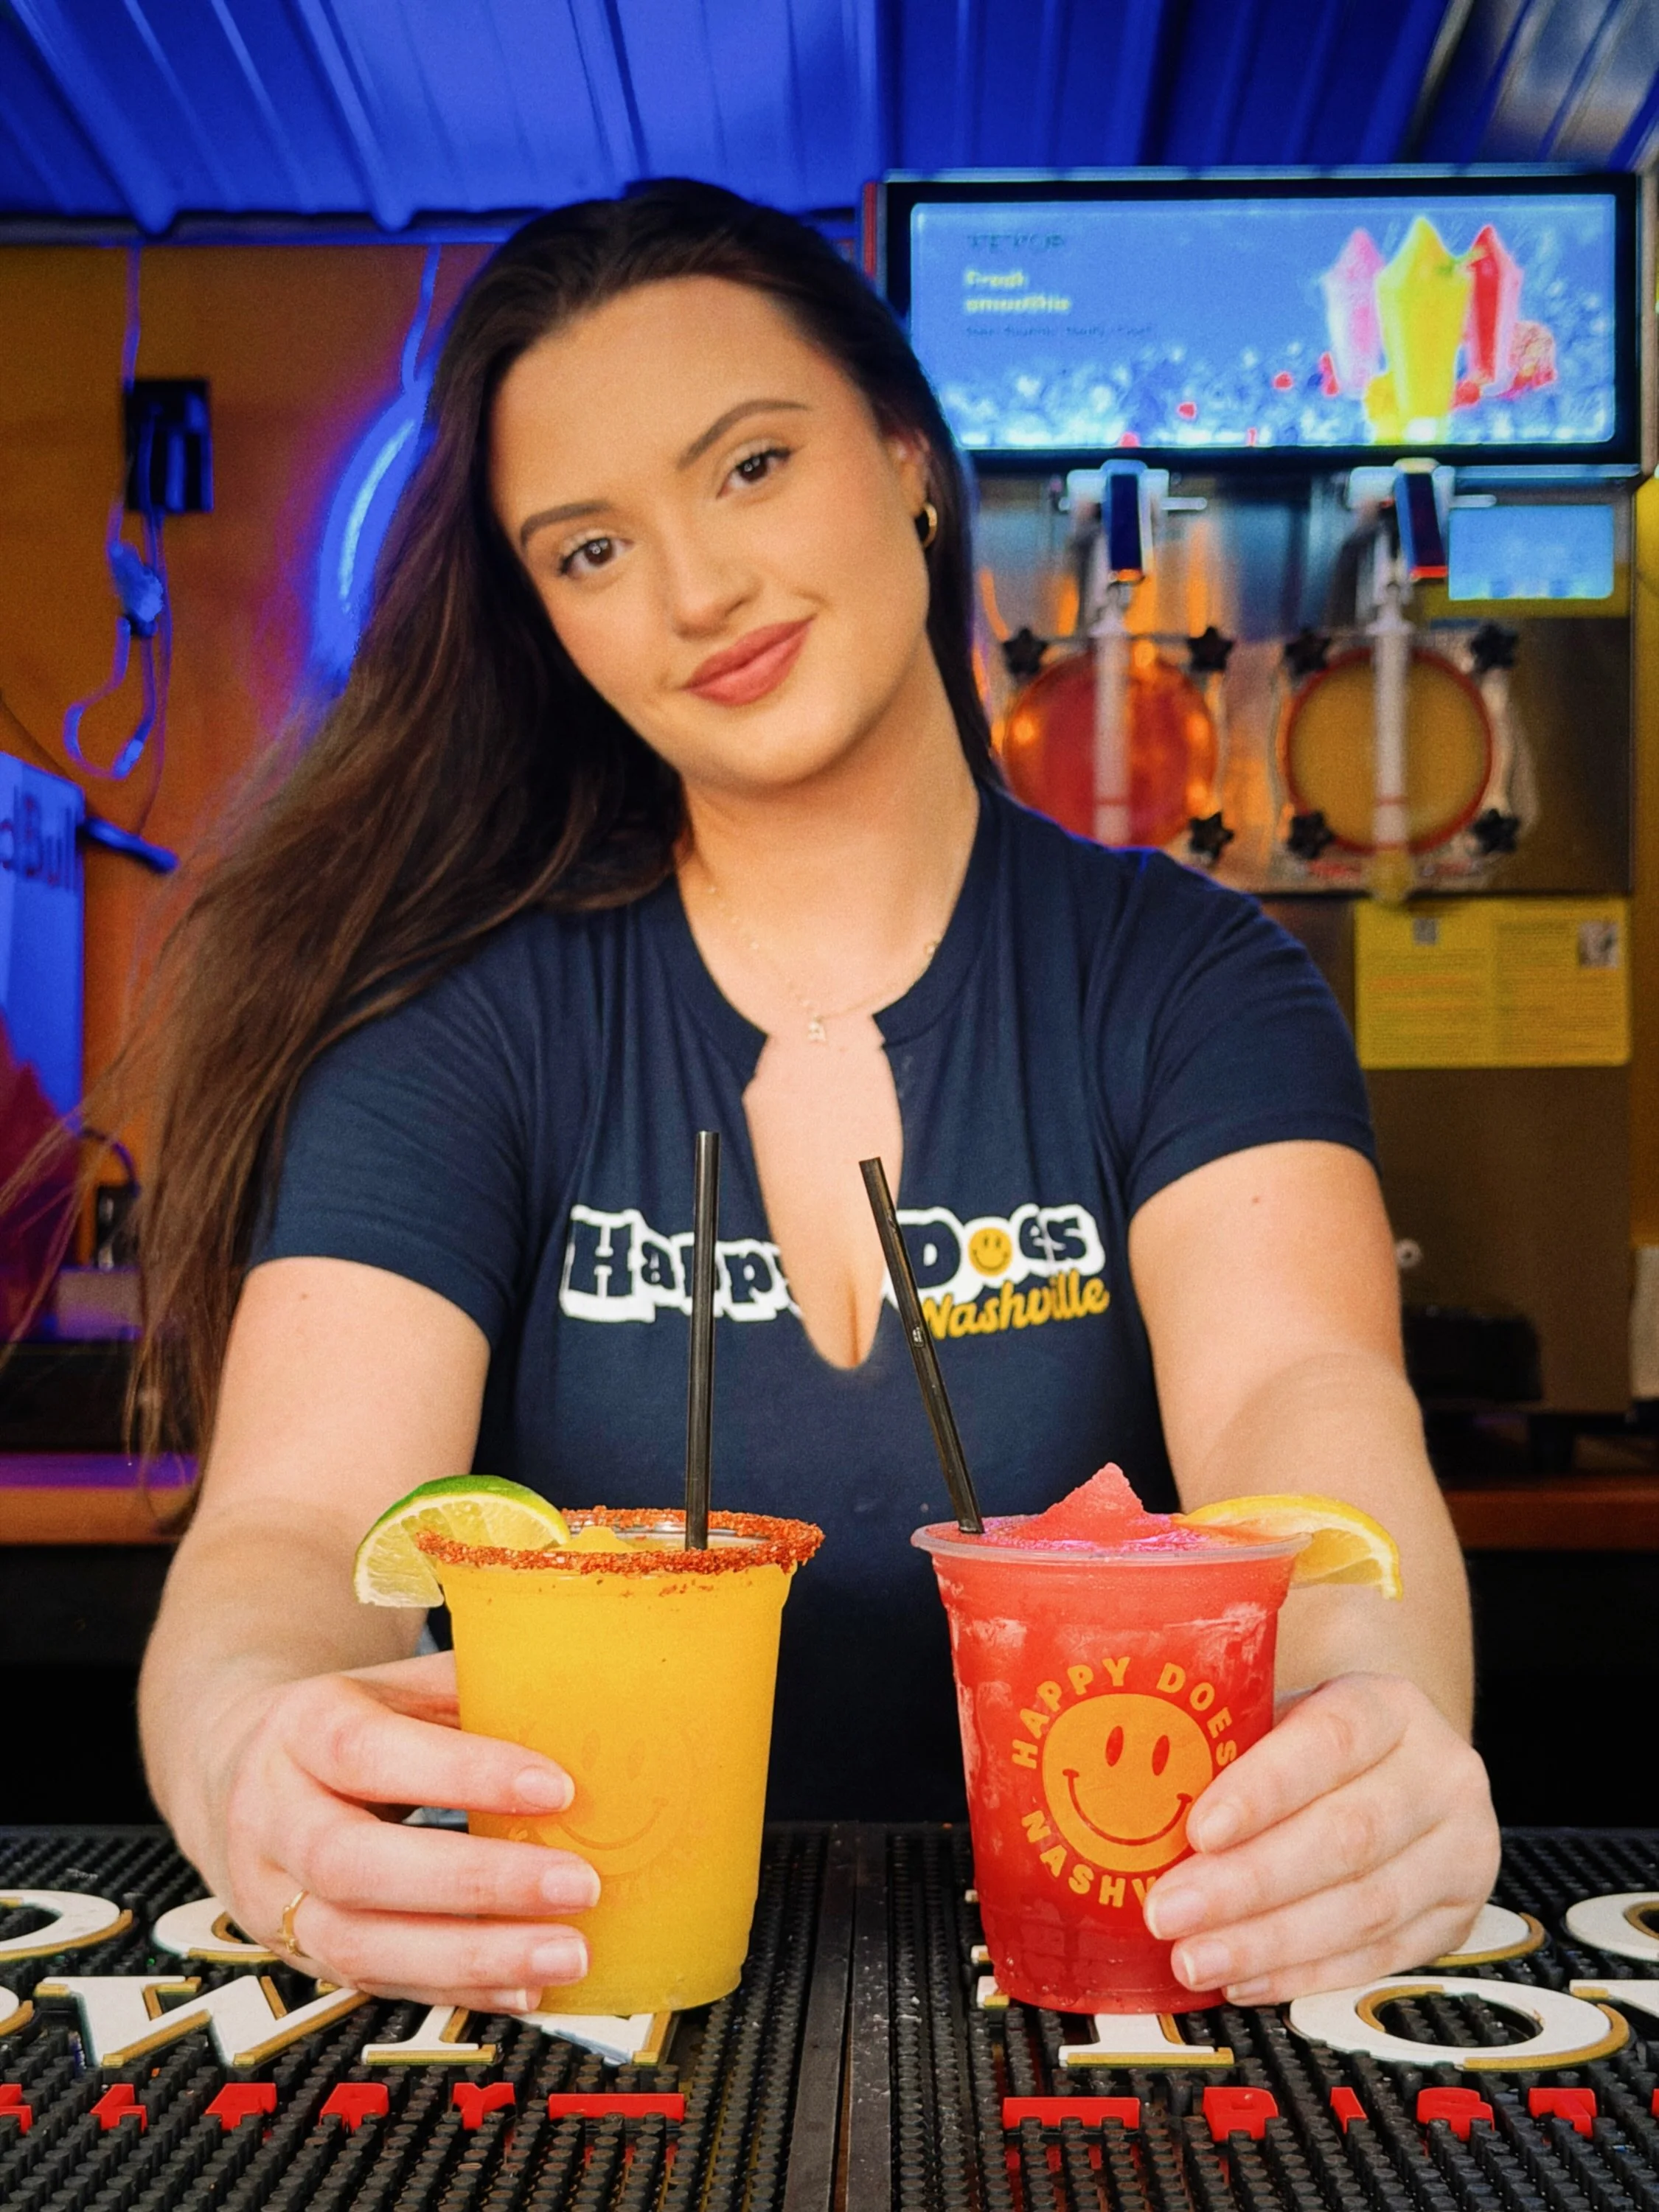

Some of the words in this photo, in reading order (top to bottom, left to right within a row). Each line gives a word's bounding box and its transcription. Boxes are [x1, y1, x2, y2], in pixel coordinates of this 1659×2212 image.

[922, 1267, 1110, 1340] Nashville
[1012, 1656, 1131, 1769] HAPPY
[1155, 1662, 1238, 1767] DOES
